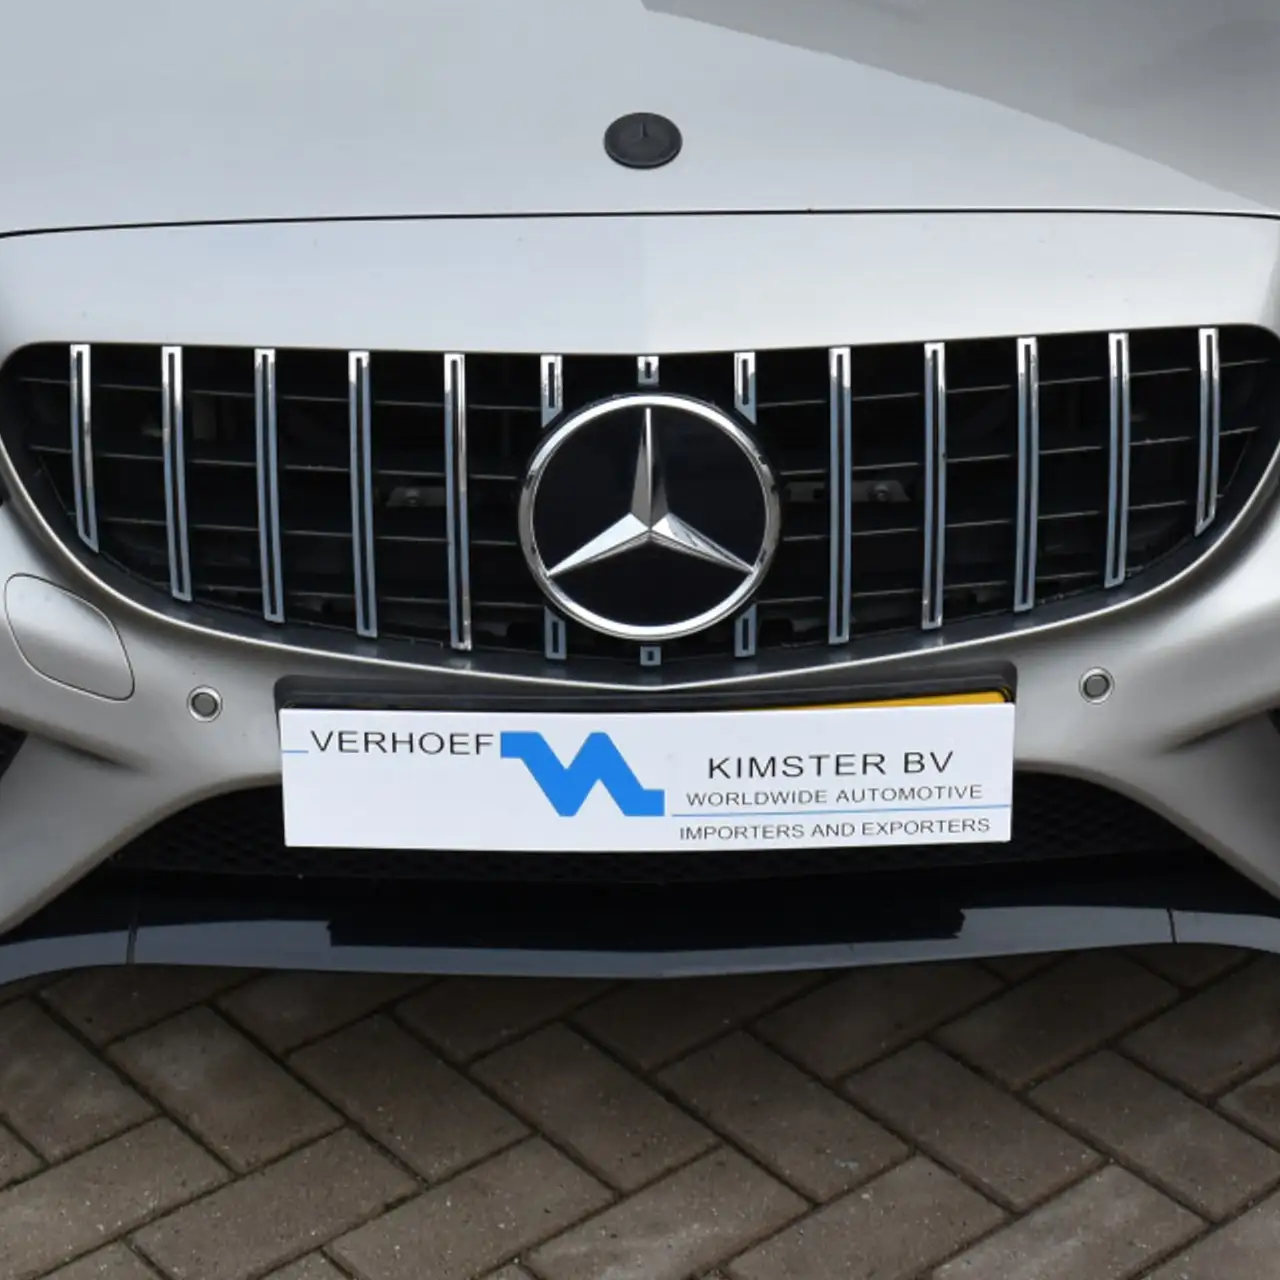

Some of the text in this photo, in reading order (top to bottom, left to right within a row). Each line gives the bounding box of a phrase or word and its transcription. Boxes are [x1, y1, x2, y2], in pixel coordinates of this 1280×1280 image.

[309, 729, 495, 756] VERHOEF
[707, 750, 954, 780] KIMSTER BV
[685, 783, 982, 807] WORLDWIDE AUTOMOTIVE
[679, 817, 991, 841] IMPORTERS AND EXPORTERS
